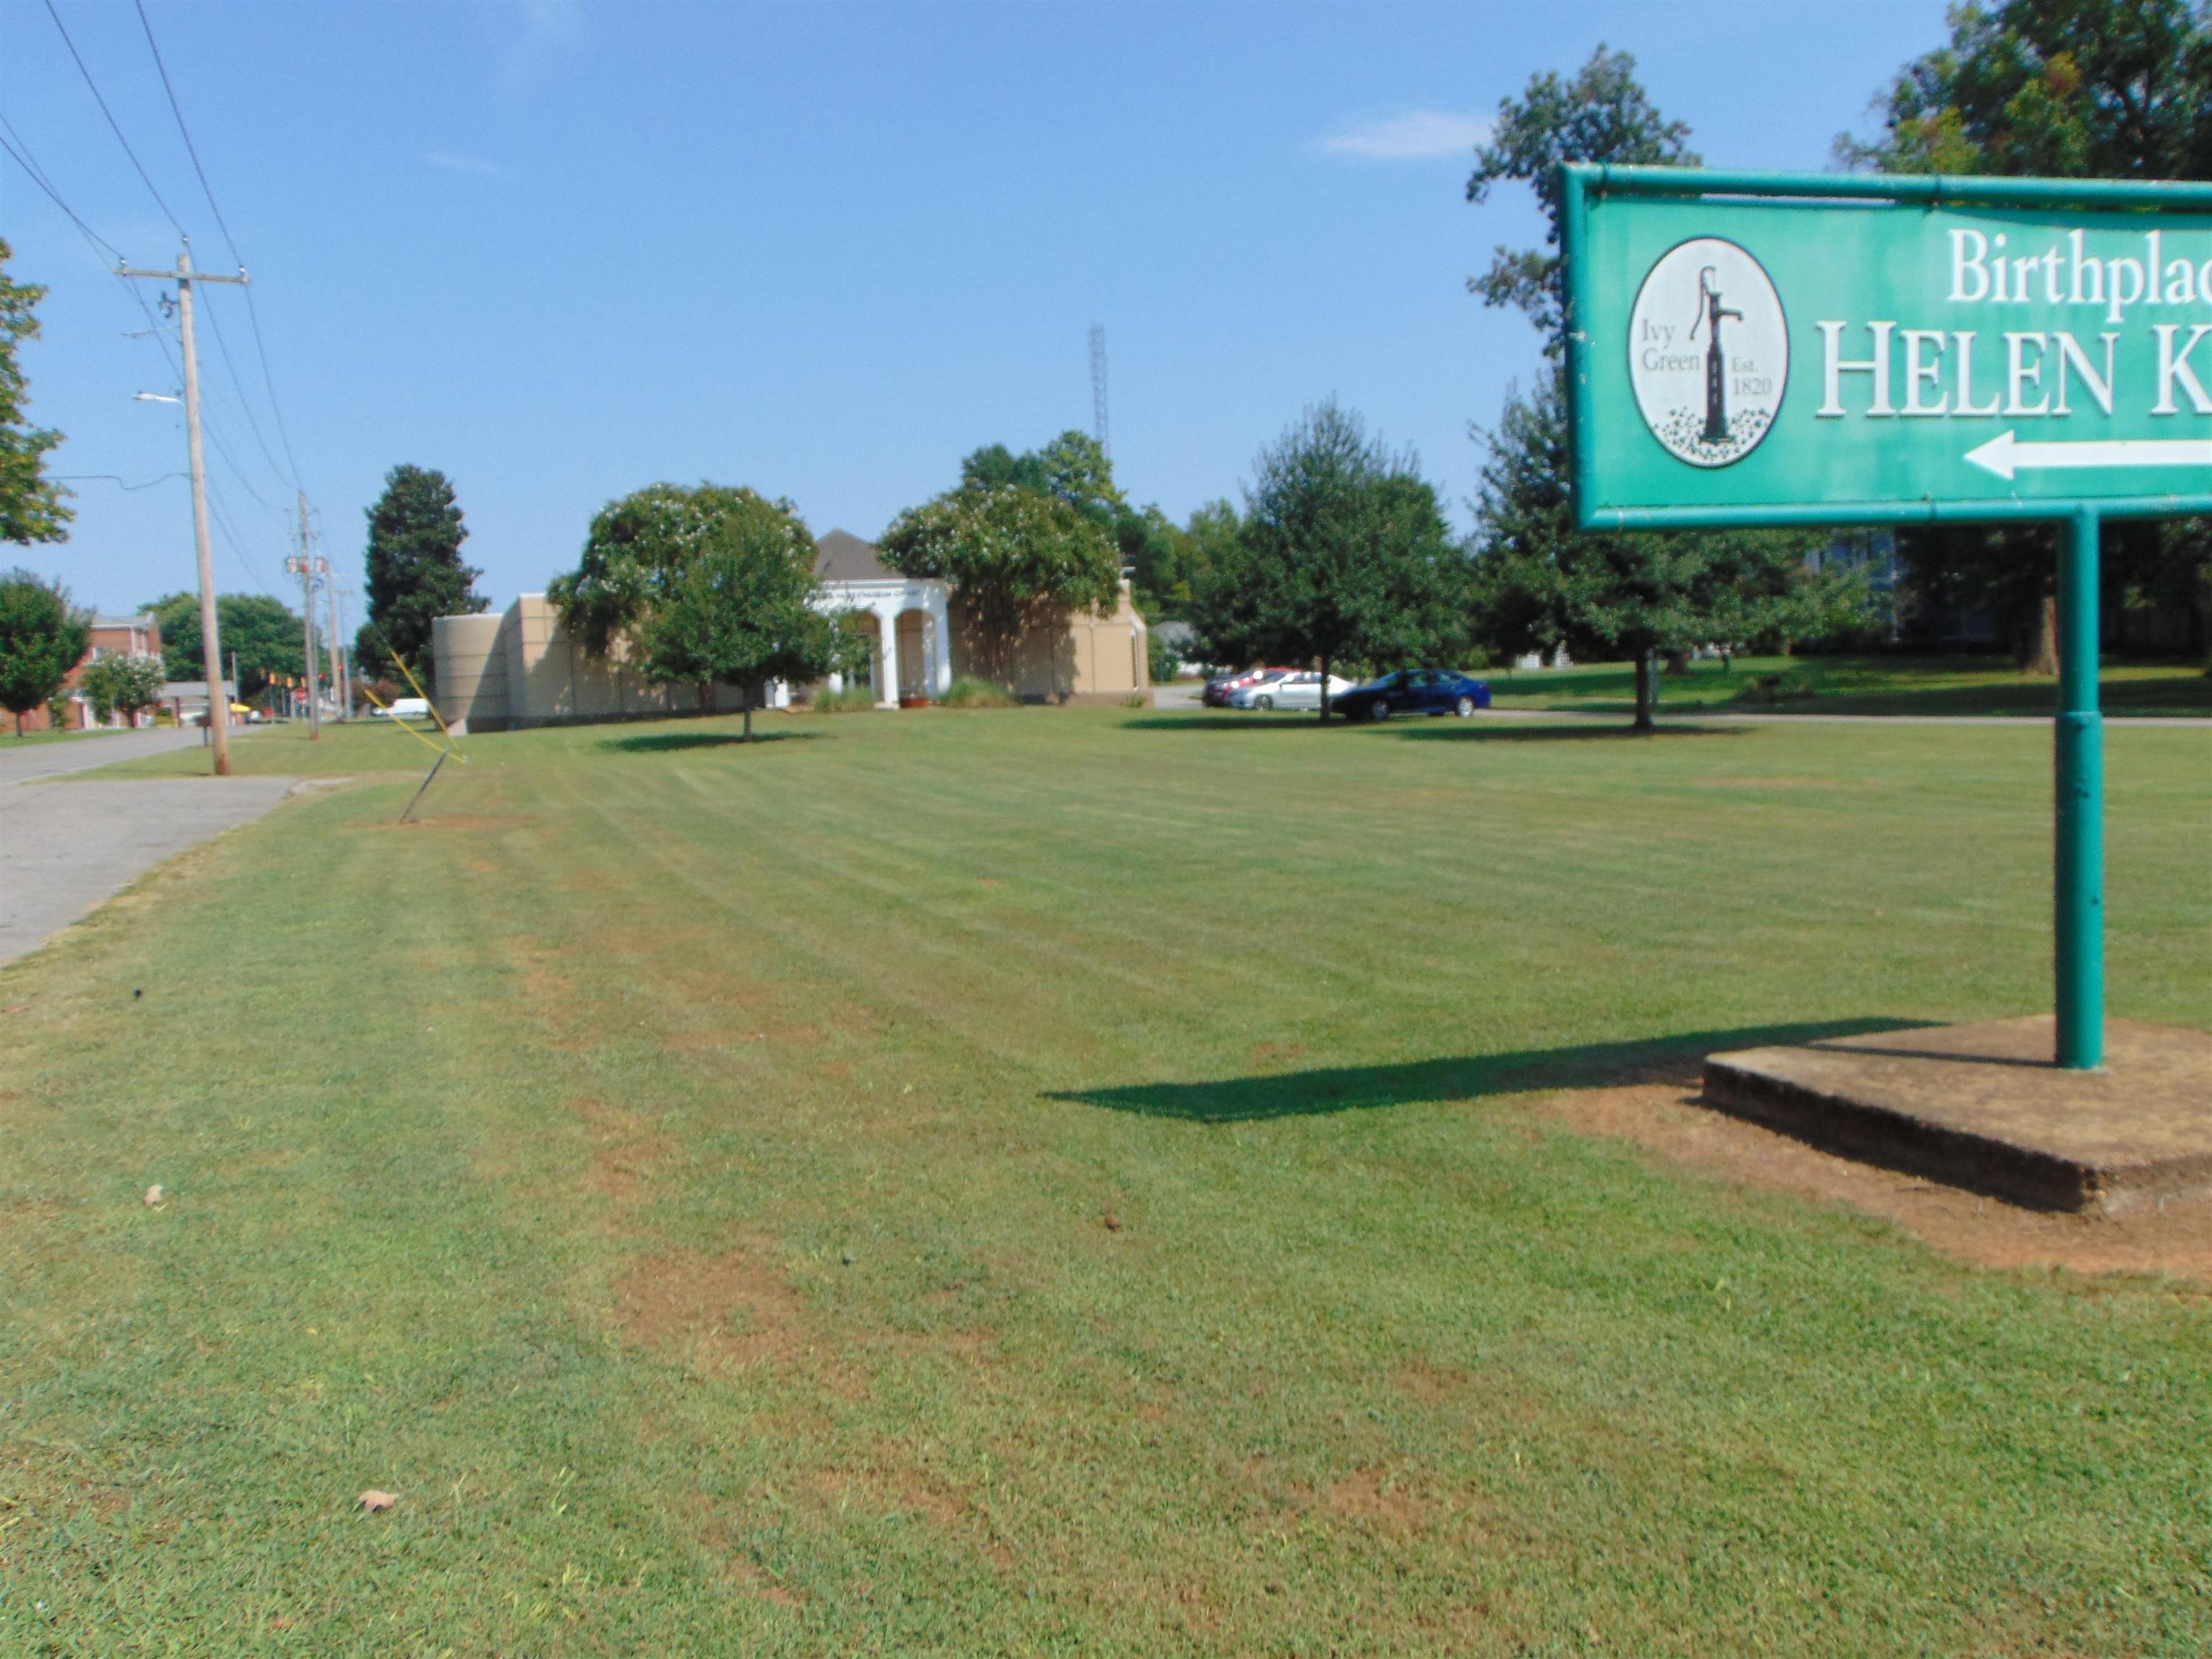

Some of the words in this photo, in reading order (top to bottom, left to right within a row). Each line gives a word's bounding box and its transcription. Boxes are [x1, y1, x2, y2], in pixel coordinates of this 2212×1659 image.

[1641, 318, 1675, 349] Ivy
[1642, 347, 1700, 371] Green
[1731, 356, 1759, 372] Est.
[1815, 320, 2121, 417] HELEN
[2150, 324, 2212, 415] K
[1732, 377, 1773, 395] 1820
